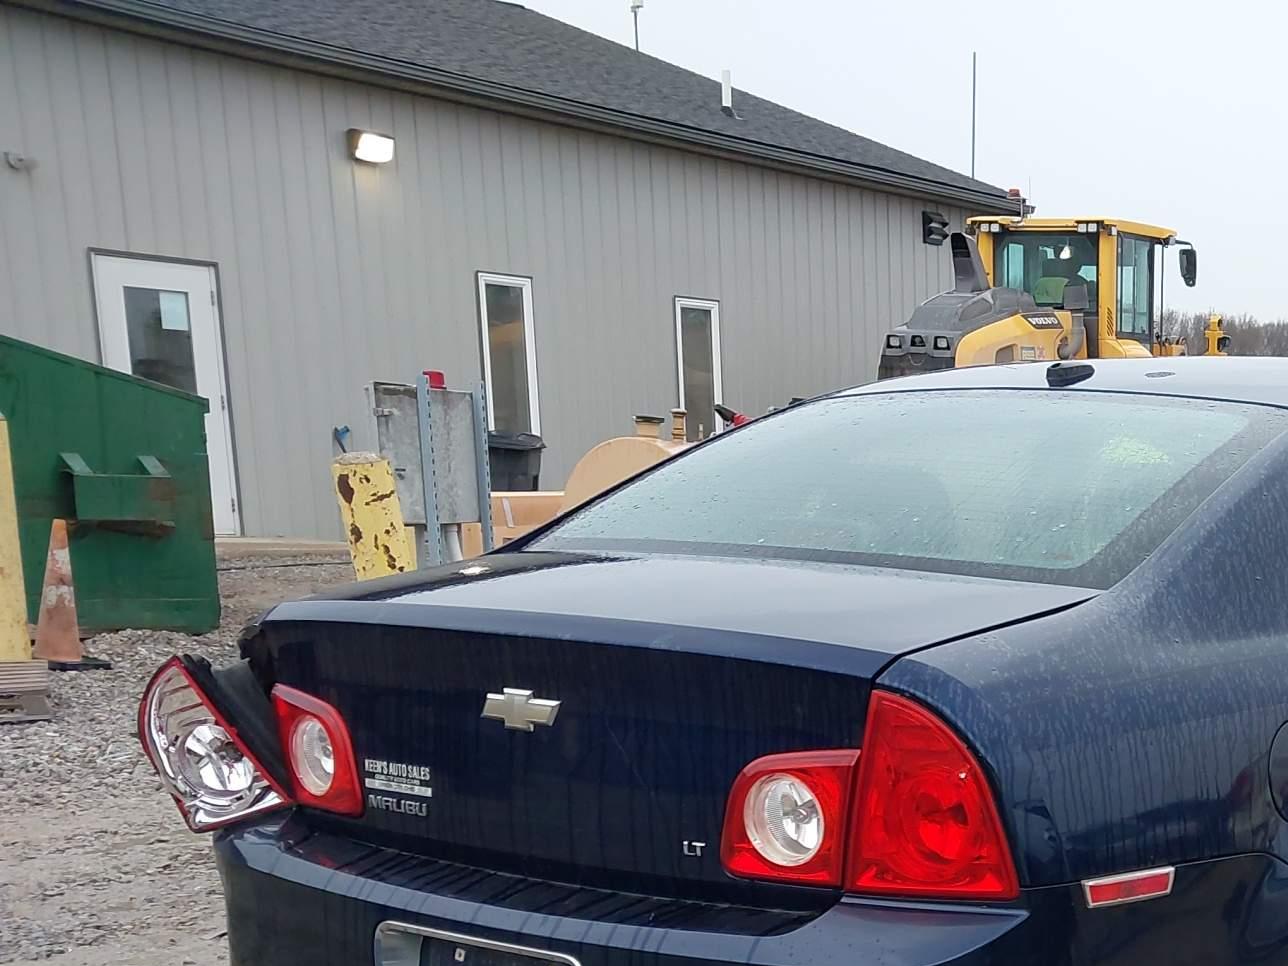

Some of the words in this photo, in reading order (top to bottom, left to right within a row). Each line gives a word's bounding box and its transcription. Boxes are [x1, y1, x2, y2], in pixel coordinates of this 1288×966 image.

[1028, 316, 1059, 325] VOLVO
[388, 762, 407, 778] AUTO
[407, 765, 430, 781] SALES
[368, 794, 427, 817] MALIBU
[683, 841, 706, 857] LT
